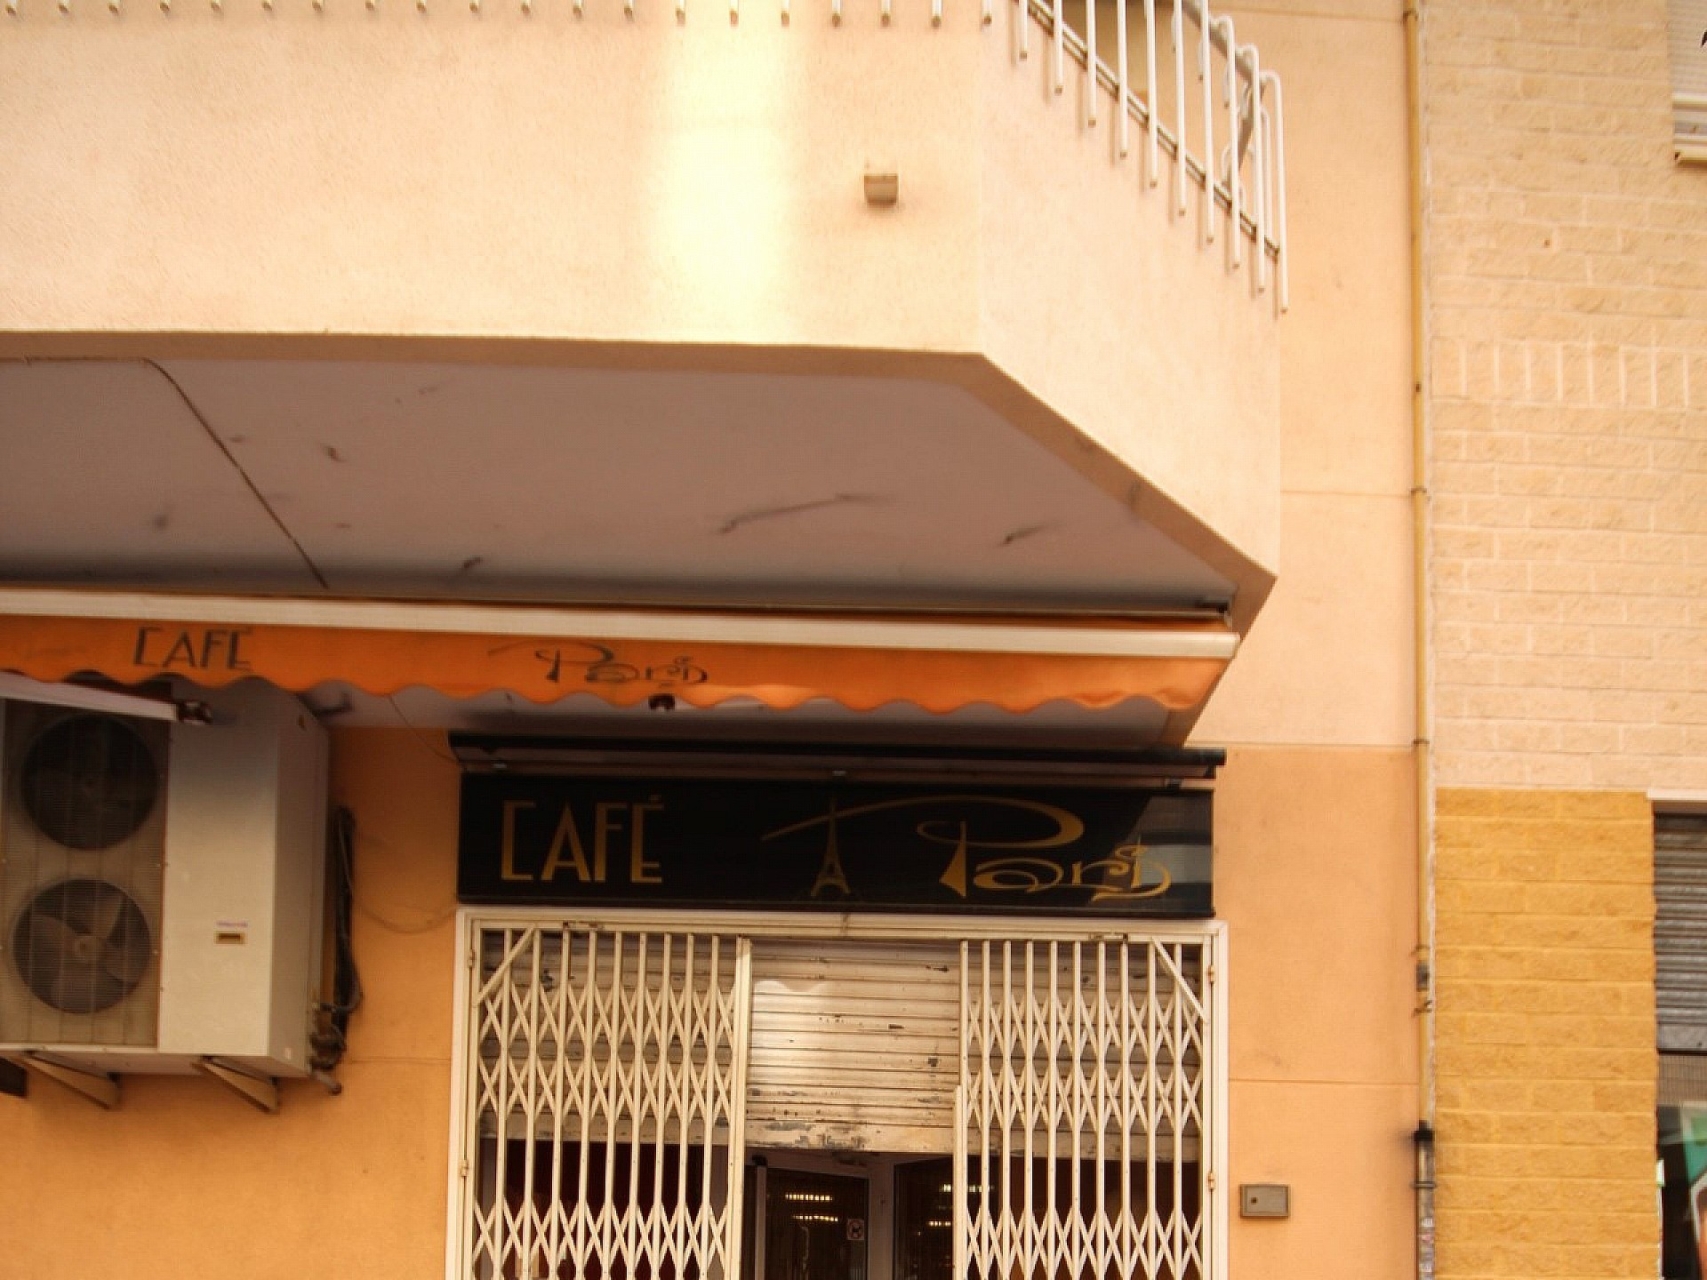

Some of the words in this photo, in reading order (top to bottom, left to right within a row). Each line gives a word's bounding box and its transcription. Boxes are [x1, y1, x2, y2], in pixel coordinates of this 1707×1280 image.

[487, 640, 708, 688] Paris
[501, 794, 664, 884] CAFÉ
[761, 795, 1172, 902] Paris
